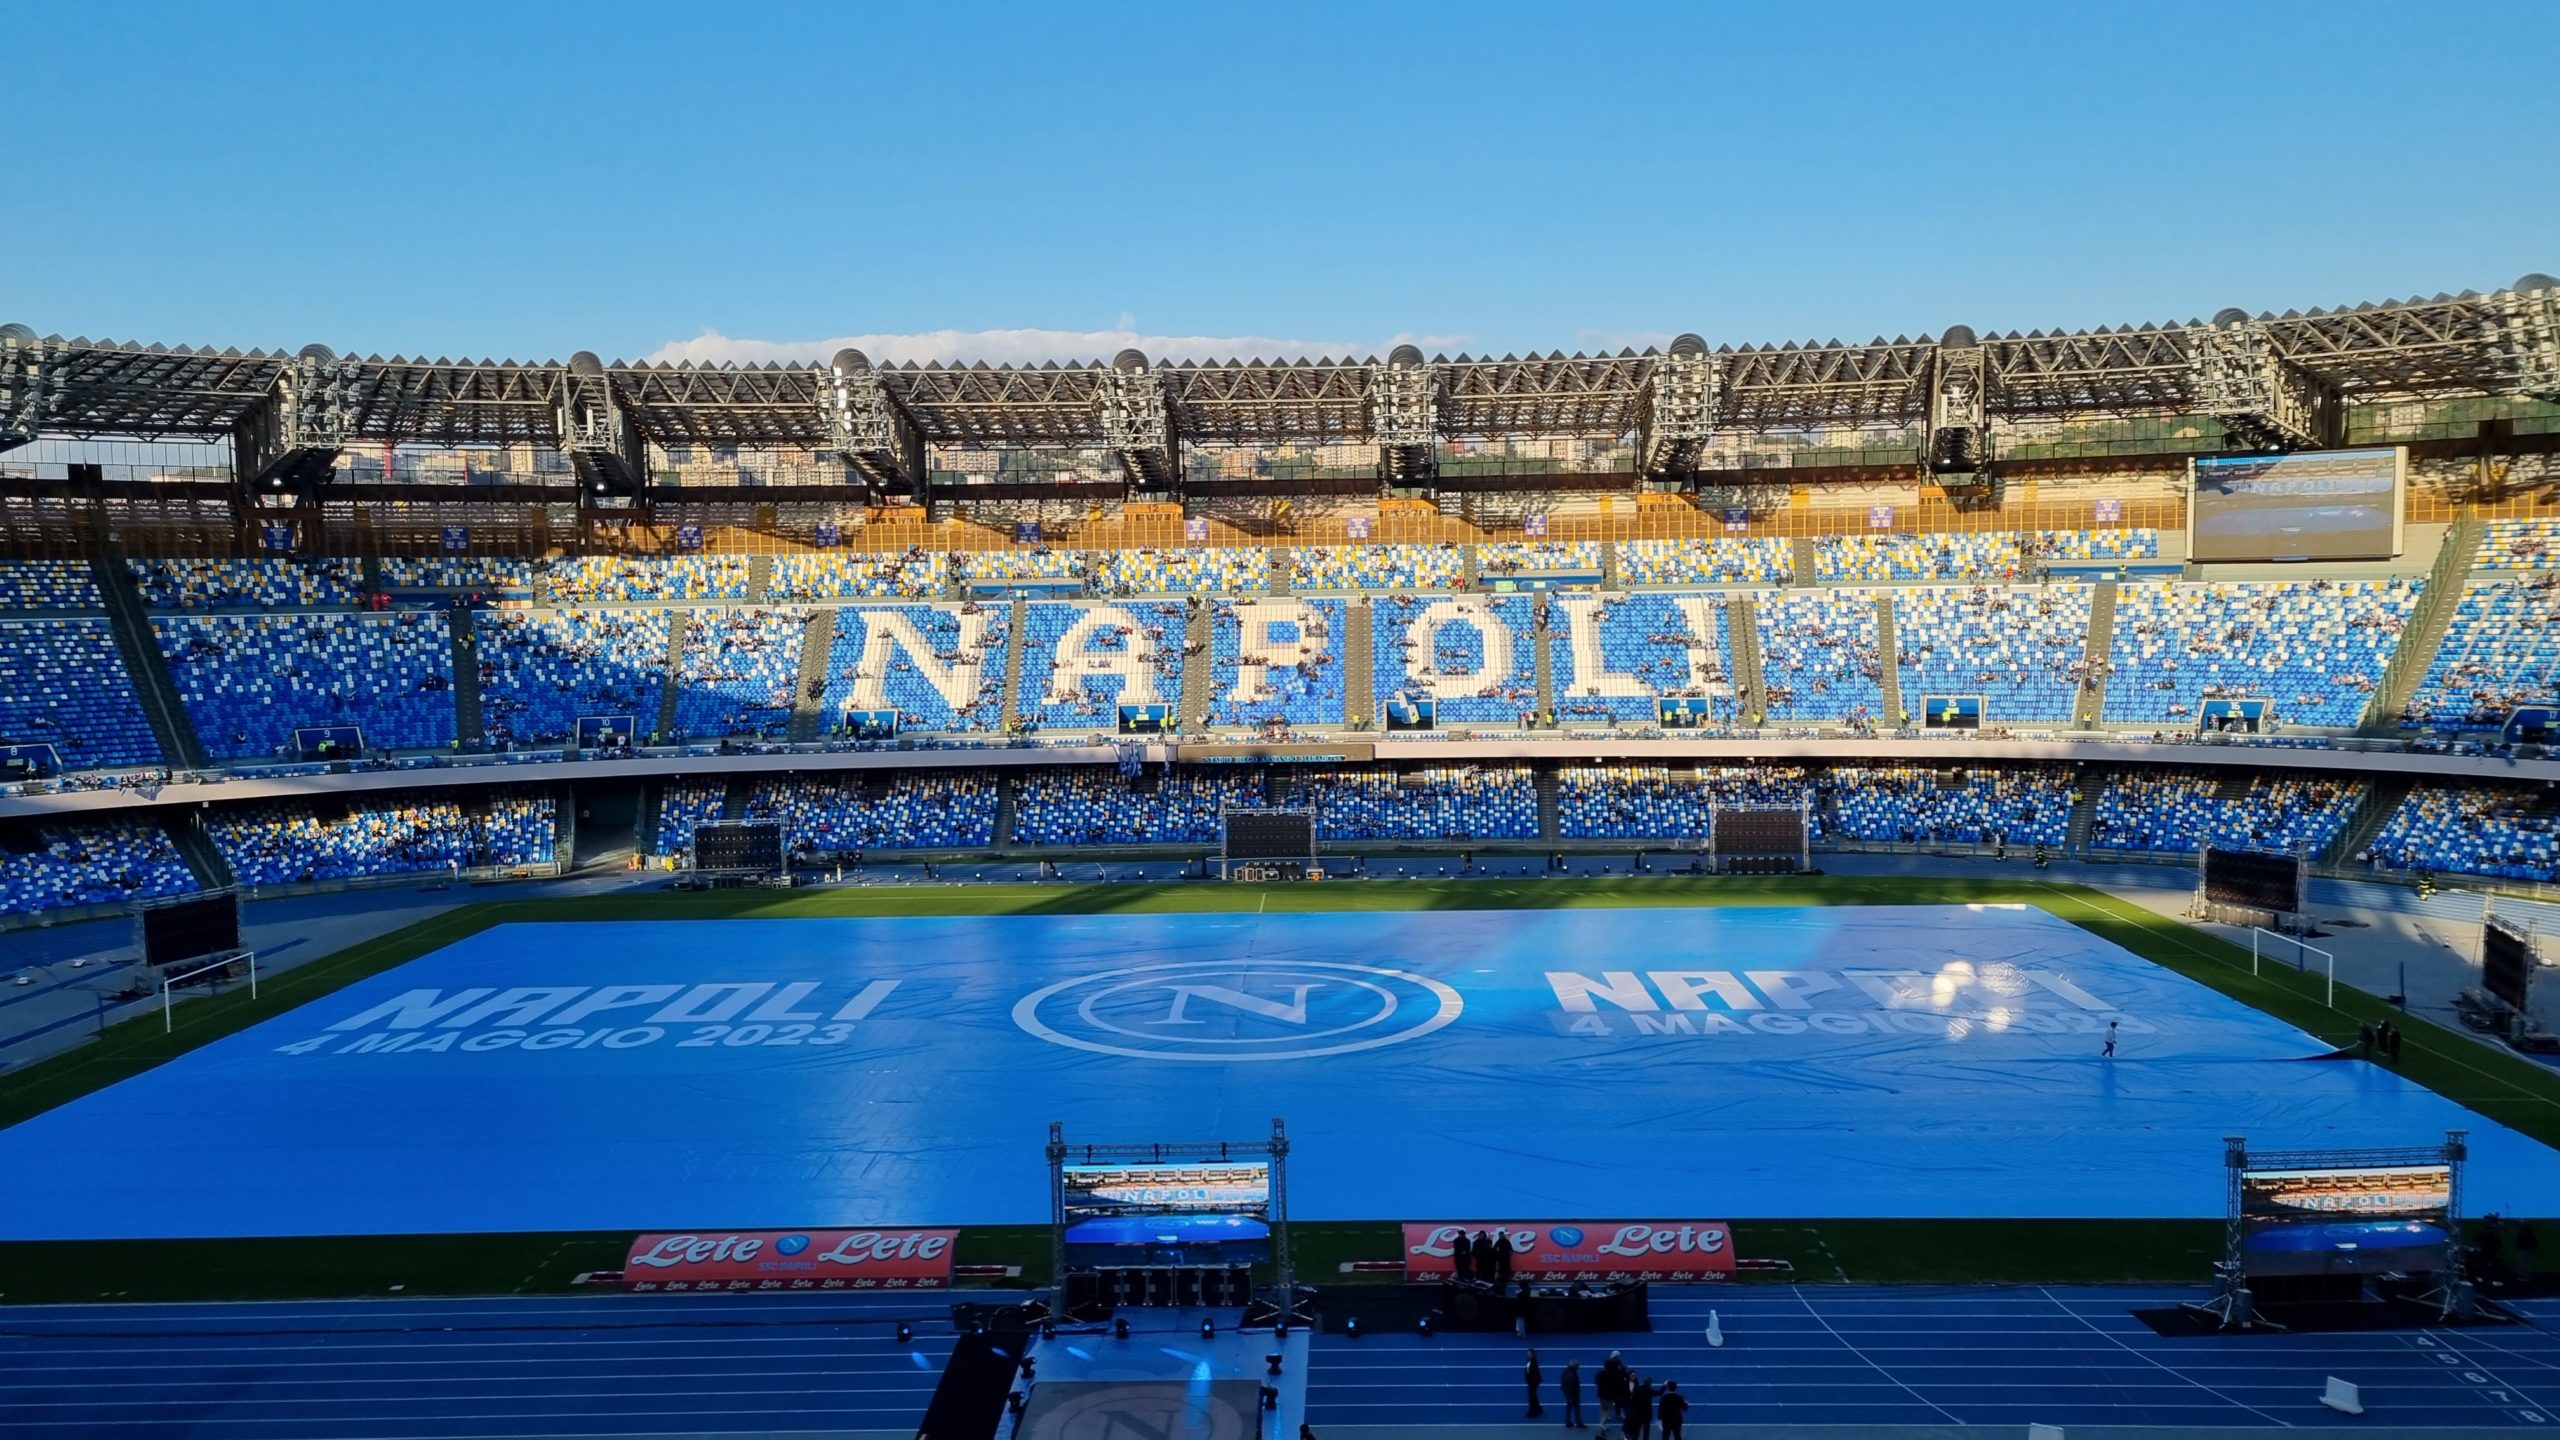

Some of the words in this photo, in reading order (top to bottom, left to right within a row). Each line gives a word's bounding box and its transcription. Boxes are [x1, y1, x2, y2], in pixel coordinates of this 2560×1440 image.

[840, 597, 1730, 710] NAPOLI
[1138, 705, 1147, 713] 12
[1947, 699, 1956, 707] 15
[322, 979, 902, 1031] NAPOLI
[1569, 1014, 1612, 1036] 4
[272, 1034, 340, 1055] 4
[332, 1026, 665, 1055] MAGGIO
[675, 1023, 855, 1047] 2023
[1597, 1225, 1724, 1257] Lete
[631, 1235, 764, 1267] Lete
[817, 1232, 948, 1265] Lete
[2417, 1337, 2435, 1347] 4
[2437, 1353, 2460, 1364] 5
[2463, 1372, 2488, 1383] 6
[2489, 1390, 2511, 1402] 7
[2520, 1410, 2546, 1423] 8
